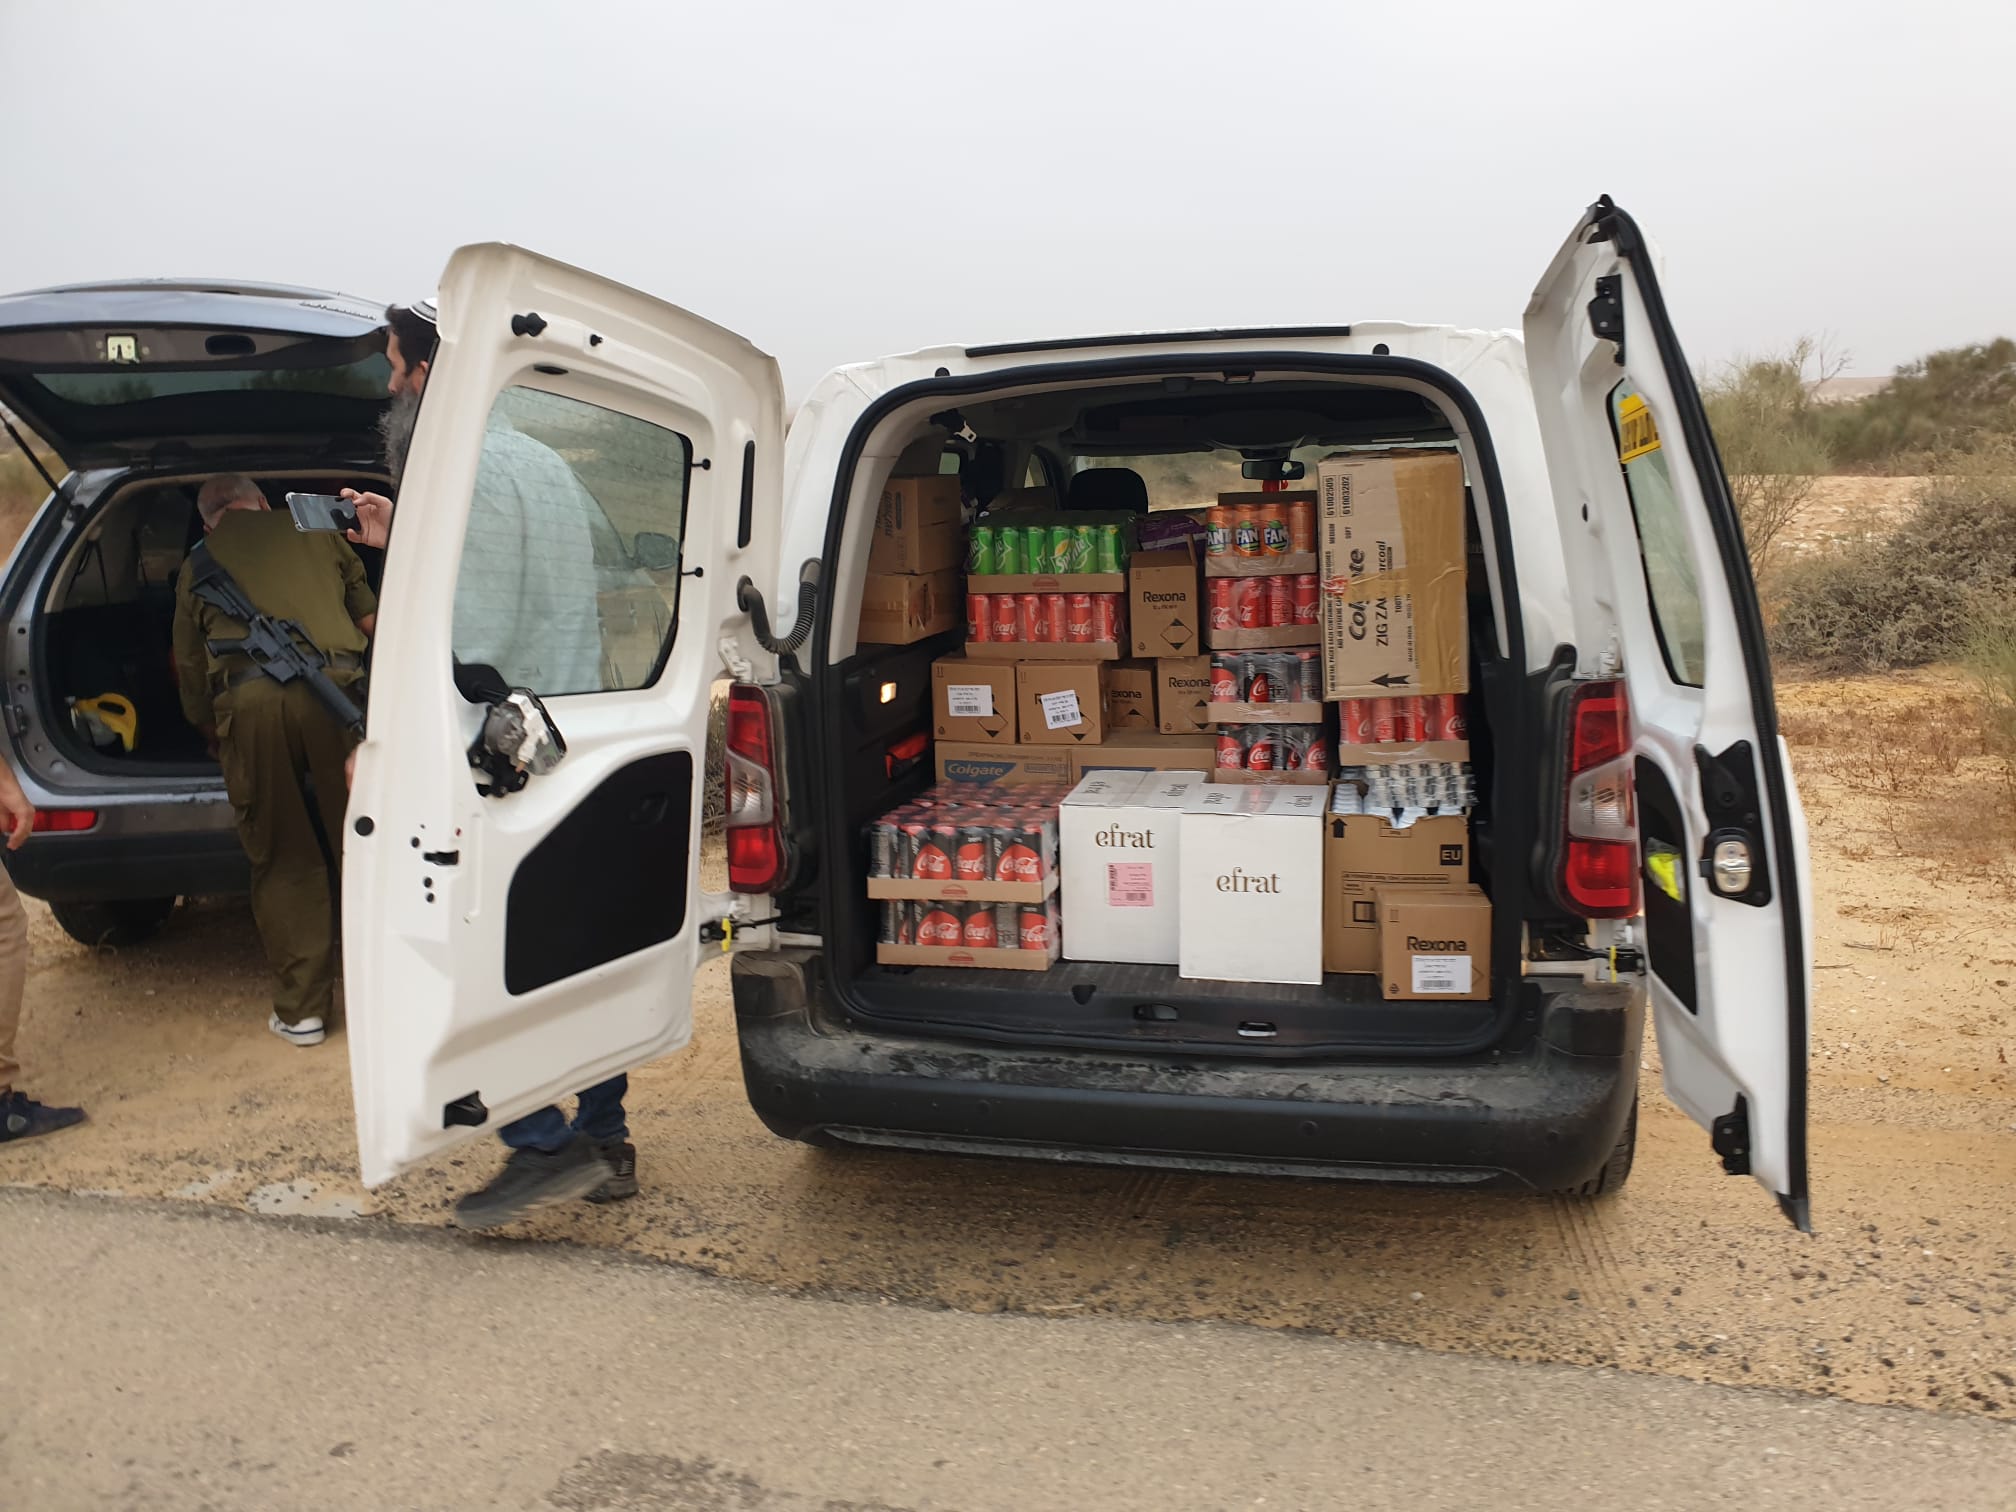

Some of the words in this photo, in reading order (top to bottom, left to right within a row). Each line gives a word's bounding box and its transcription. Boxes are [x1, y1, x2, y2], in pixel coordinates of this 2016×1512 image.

[1235, 528, 1259, 545] FAN
[1143, 591, 1186, 603] Rexona
[1348, 548, 1371, 641] Colte
[1376, 623, 1389, 647] ZIG
[1168, 676, 1211, 688] Rexona
[1111, 690, 1142, 699] exona
[947, 763, 1004, 777] Colgate
[1095, 822, 1155, 849] efrat
[1441, 849, 1461, 861] EU
[1216, 866, 1281, 894] efrat
[1406, 935, 1467, 951] Rexona
